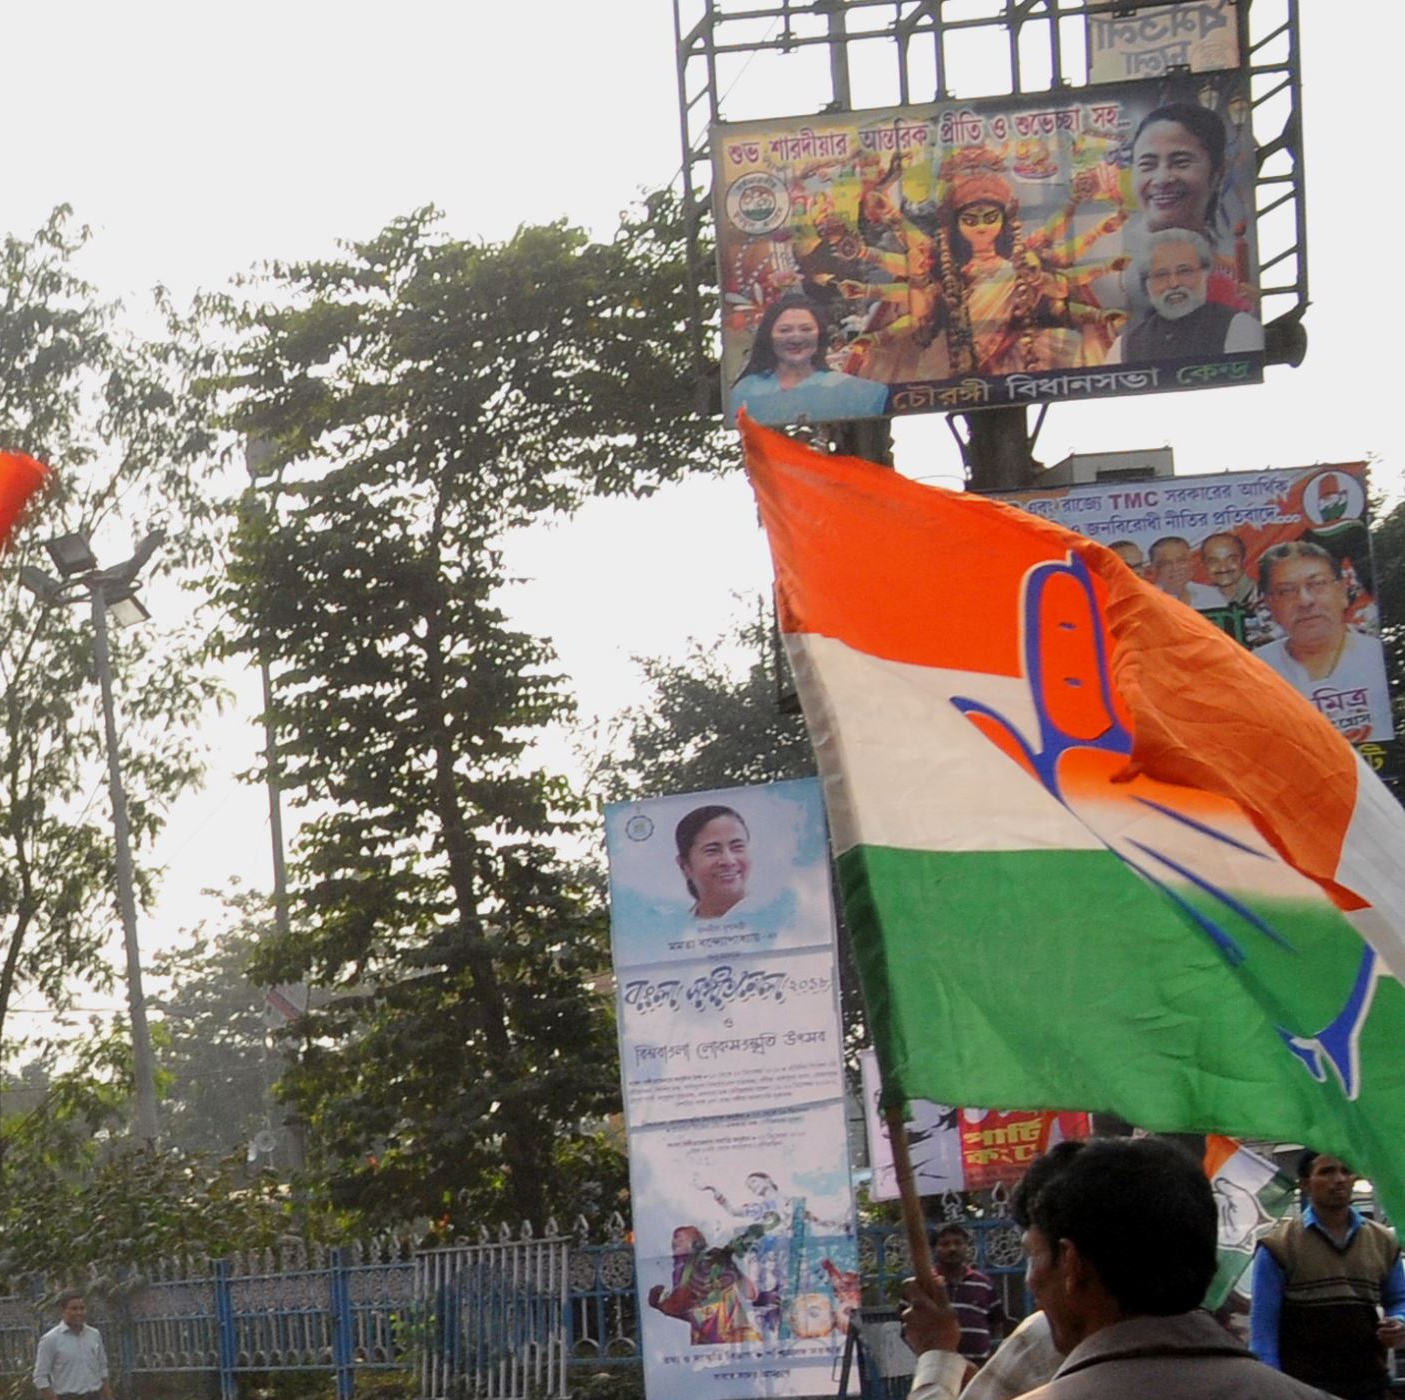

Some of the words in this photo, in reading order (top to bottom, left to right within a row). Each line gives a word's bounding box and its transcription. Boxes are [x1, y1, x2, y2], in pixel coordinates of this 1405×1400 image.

[728, 141, 761, 165] শুভ
[769, 127, 848, 161] শারদীয়ার
[859, 117, 929, 151] আন্তরিক
[940, 111, 983, 144] প্রীতি
[994, 117, 1008, 138] ও
[1015, 108, 1081, 136] শুভেচ্ছা
[893, 379, 992, 409] চৌরঙ্গী
[1006, 366, 1159, 399] বিধানসভা
[1176, 358, 1251, 382] কেন্দ্র
[1108, 491, 1159, 510] TMC
[1165, 484, 1232, 503] সরকারের
[1238, 475, 1289, 497] আর্থিক
[1086, 511, 1161, 536] জনবিরোধী
[1166, 507, 1208, 530] নীতির
[724, 1017, 734, 1028] ও
